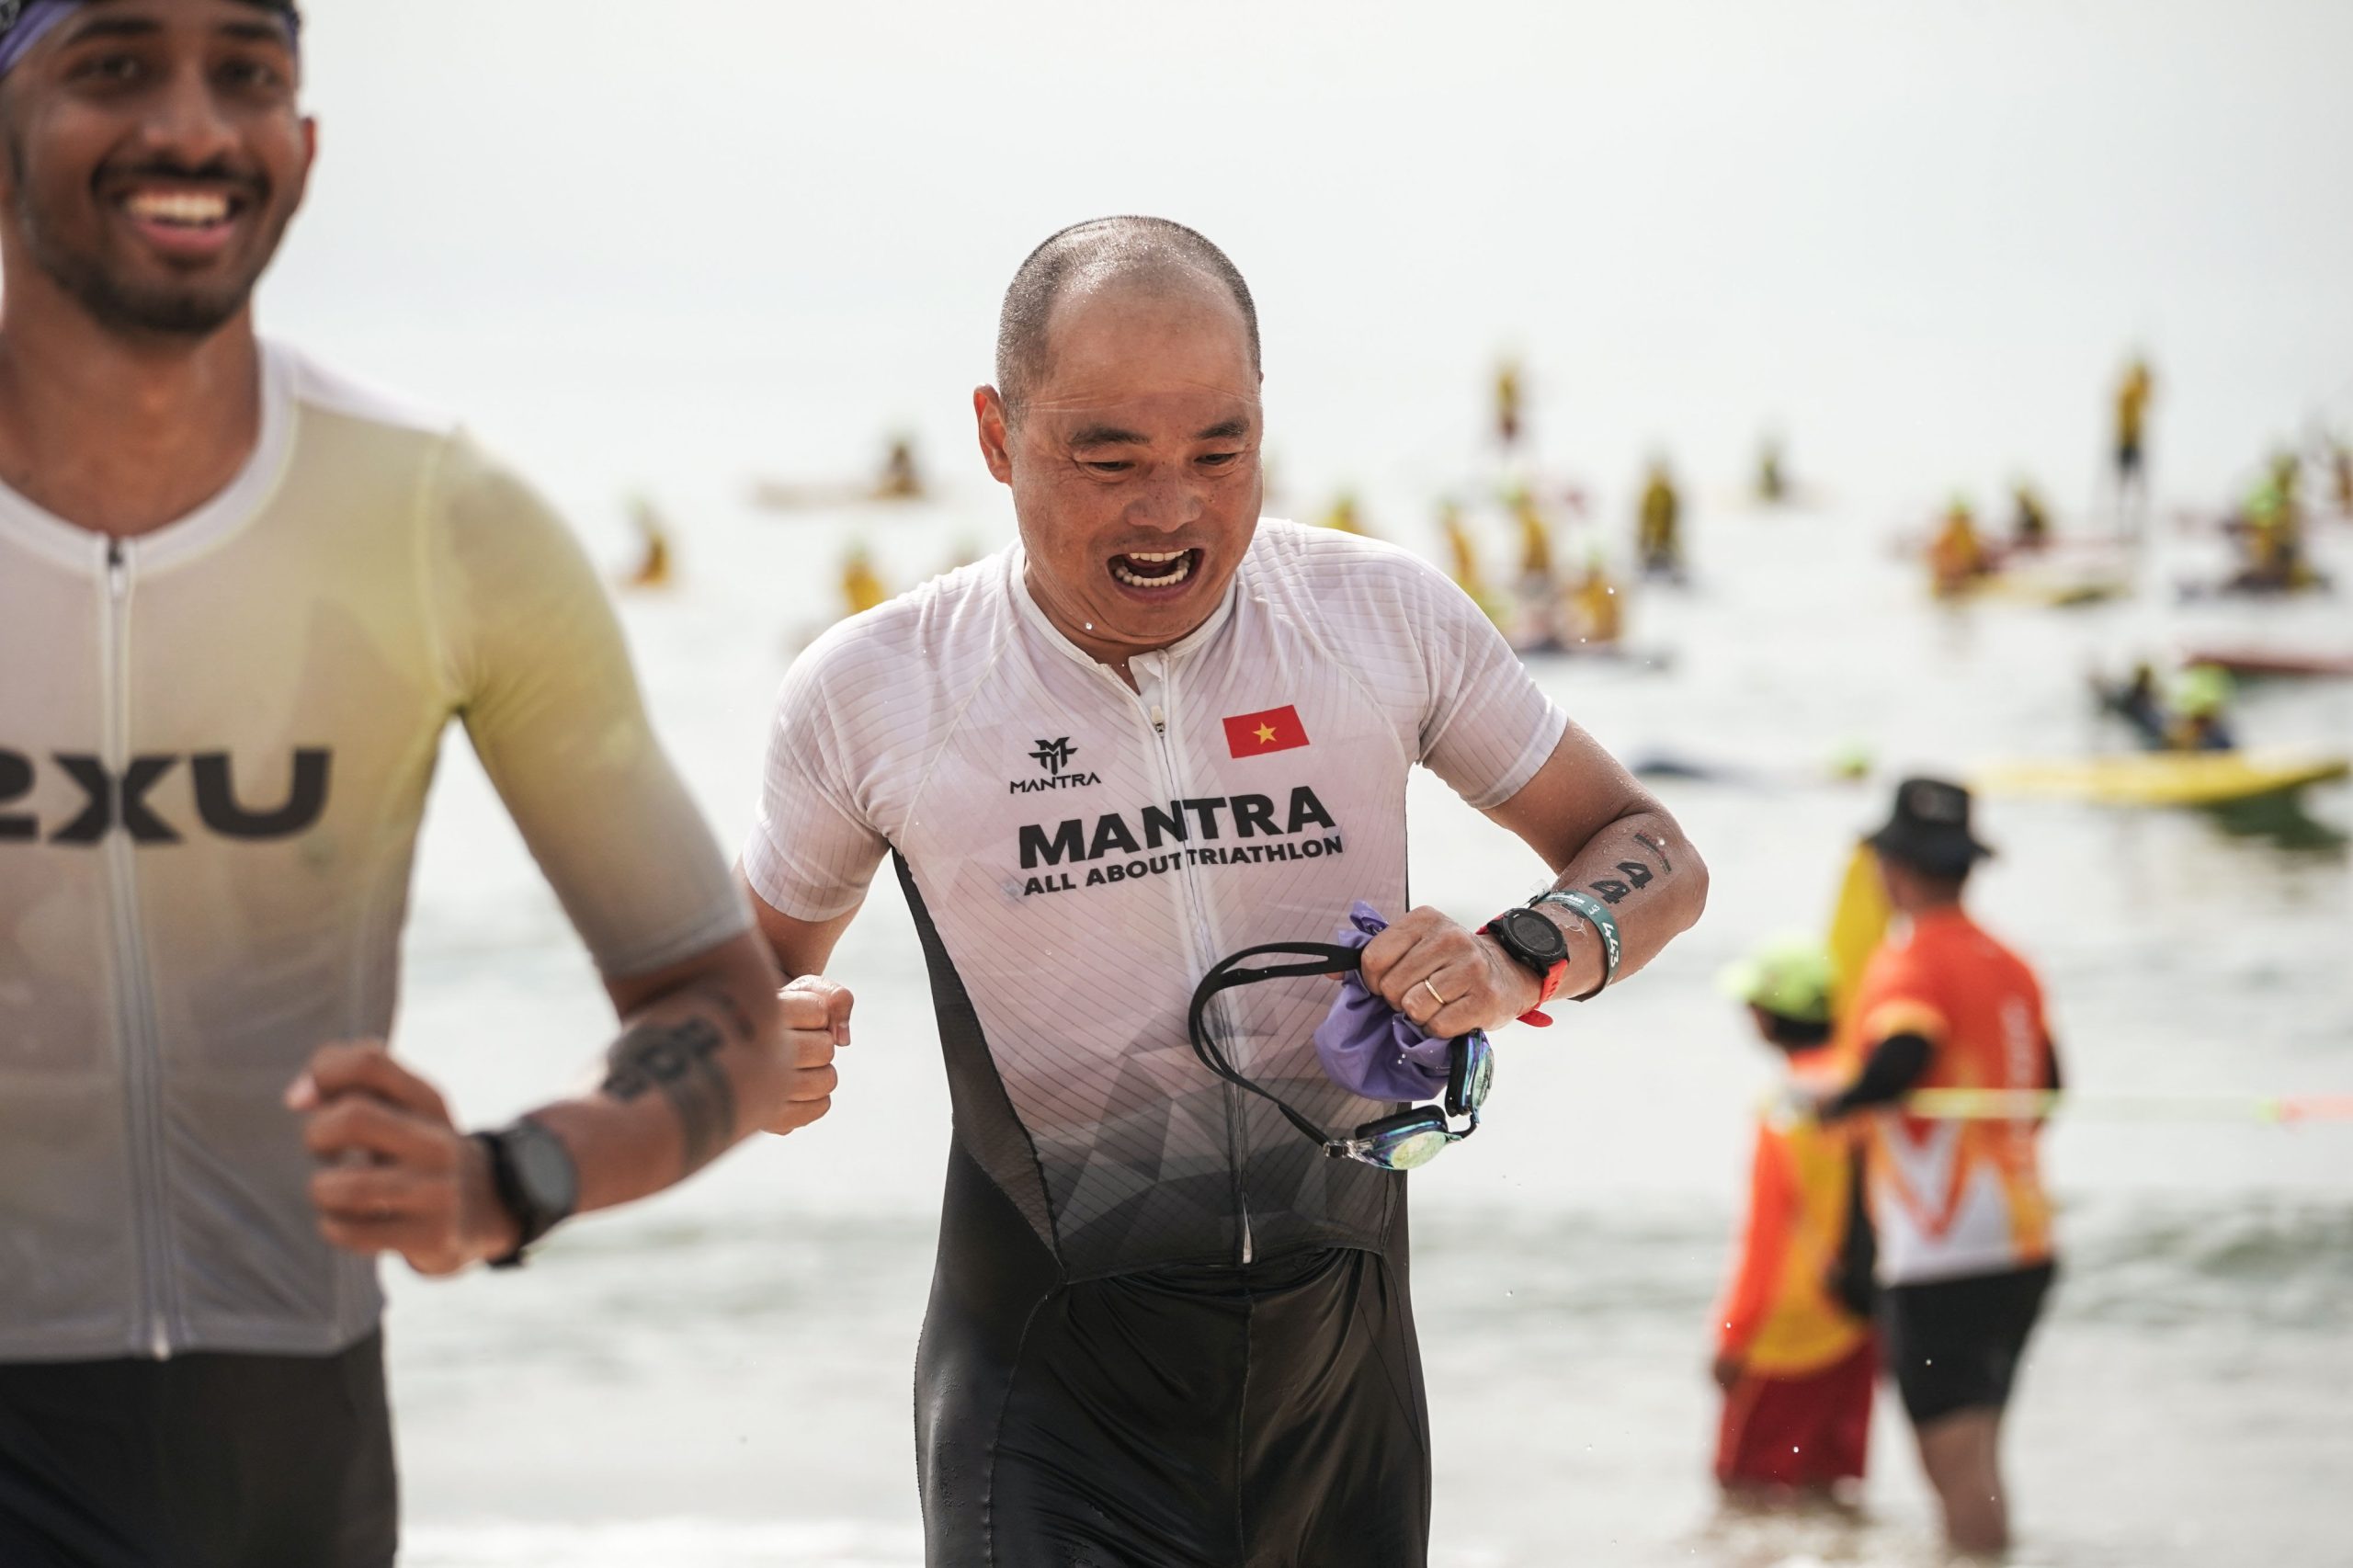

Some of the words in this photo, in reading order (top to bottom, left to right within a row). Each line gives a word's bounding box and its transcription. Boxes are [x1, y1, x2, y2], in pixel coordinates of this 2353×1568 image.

[1009, 771, 1102, 794] MANTRA
[1018, 786, 1336, 869] MANTRA
[1023, 874, 1076, 896] ALL
[1086, 852, 1182, 887] ABOUT
[1187, 835, 1344, 867] TRIATHLON
[1601, 922, 1620, 968] 443
